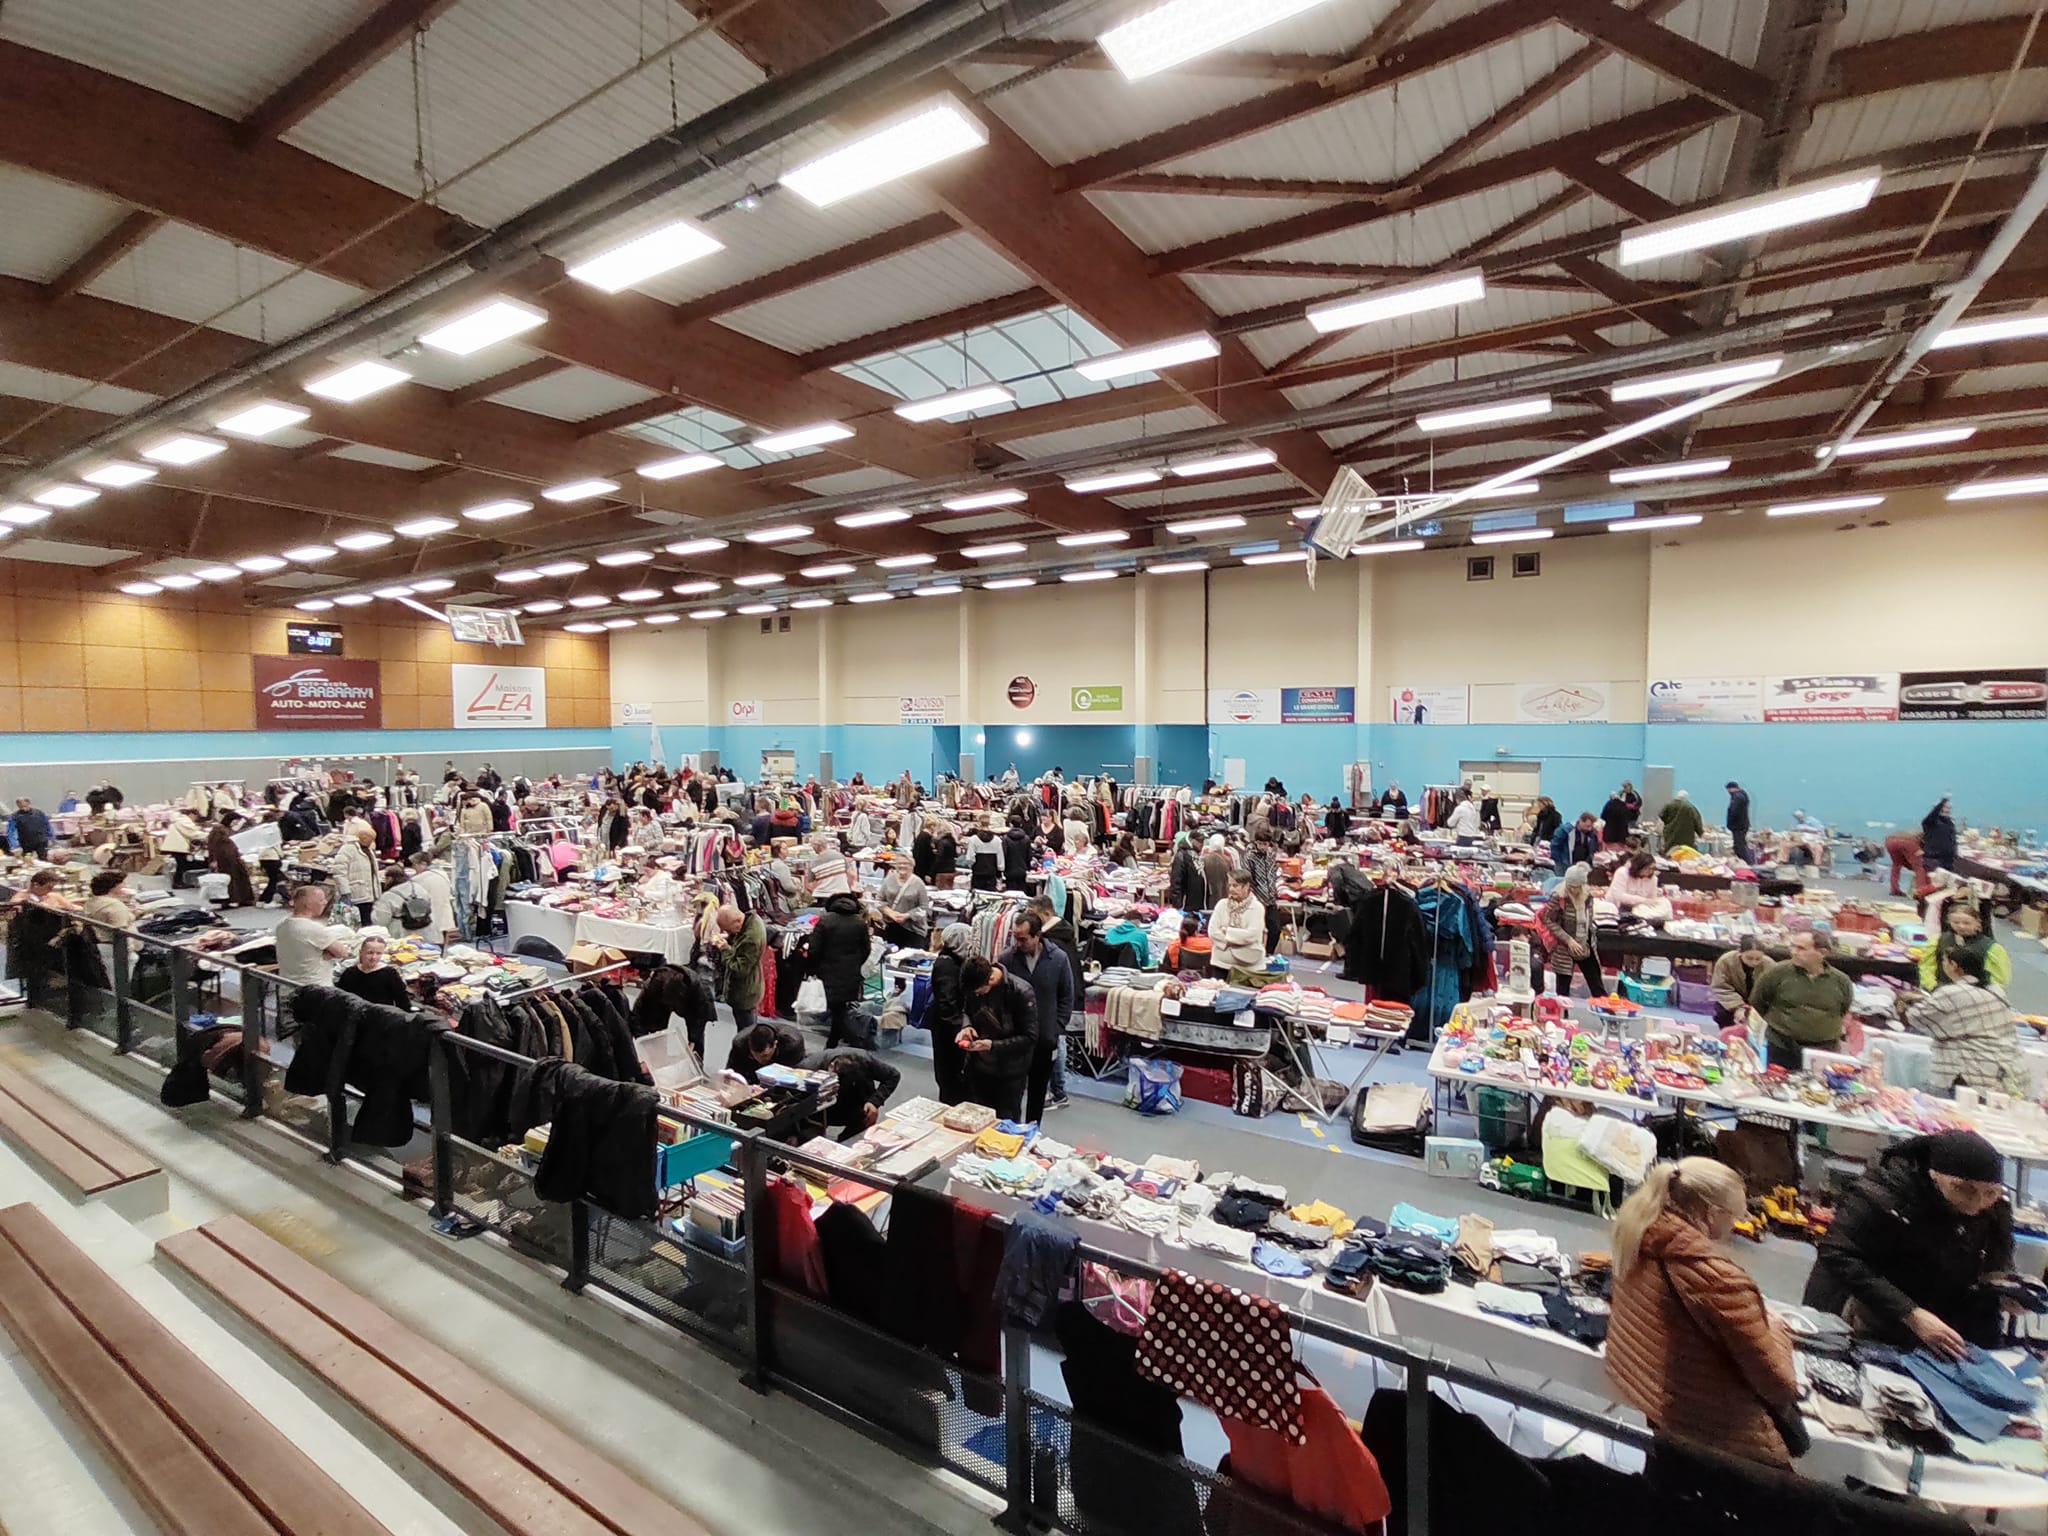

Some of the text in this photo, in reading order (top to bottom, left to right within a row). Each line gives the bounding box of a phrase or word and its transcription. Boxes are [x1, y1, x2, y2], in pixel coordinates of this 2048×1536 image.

[495, 684, 532, 692] Maisons
[1803, 691, 1851, 702] Gogo
[733, 700, 755, 717] Orpi
